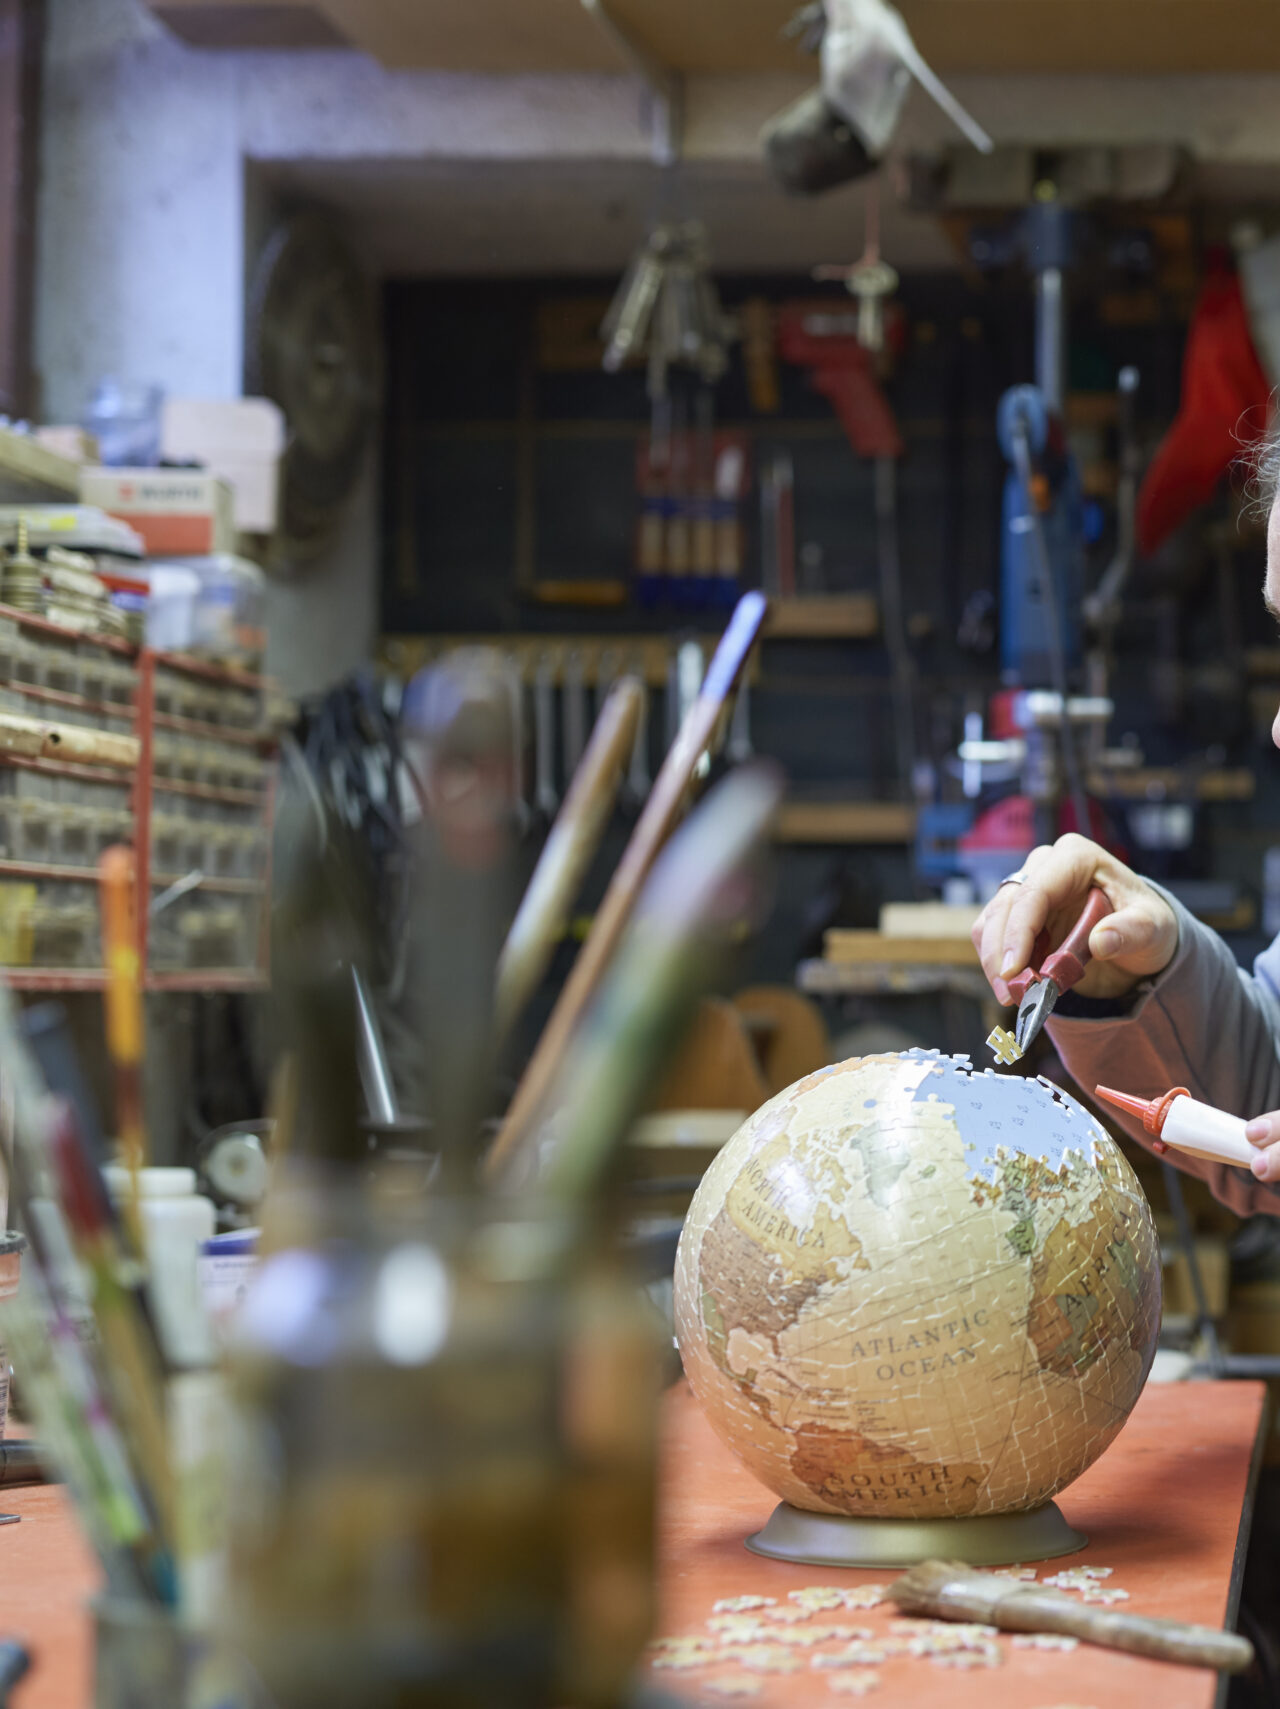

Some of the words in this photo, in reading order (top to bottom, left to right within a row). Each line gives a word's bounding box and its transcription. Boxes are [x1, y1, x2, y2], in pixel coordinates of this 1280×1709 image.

[746, 1159, 788, 1210] NORTH
[741, 1200, 825, 1248] AMERICA
[1065, 1210, 1131, 1317] AFRICA
[851, 1309, 990, 1358] ATLANTIC
[876, 1343, 977, 1381] OCEAN
[817, 1474, 981, 1502] AMERICA
[828, 1464, 950, 1488] SOUTH
